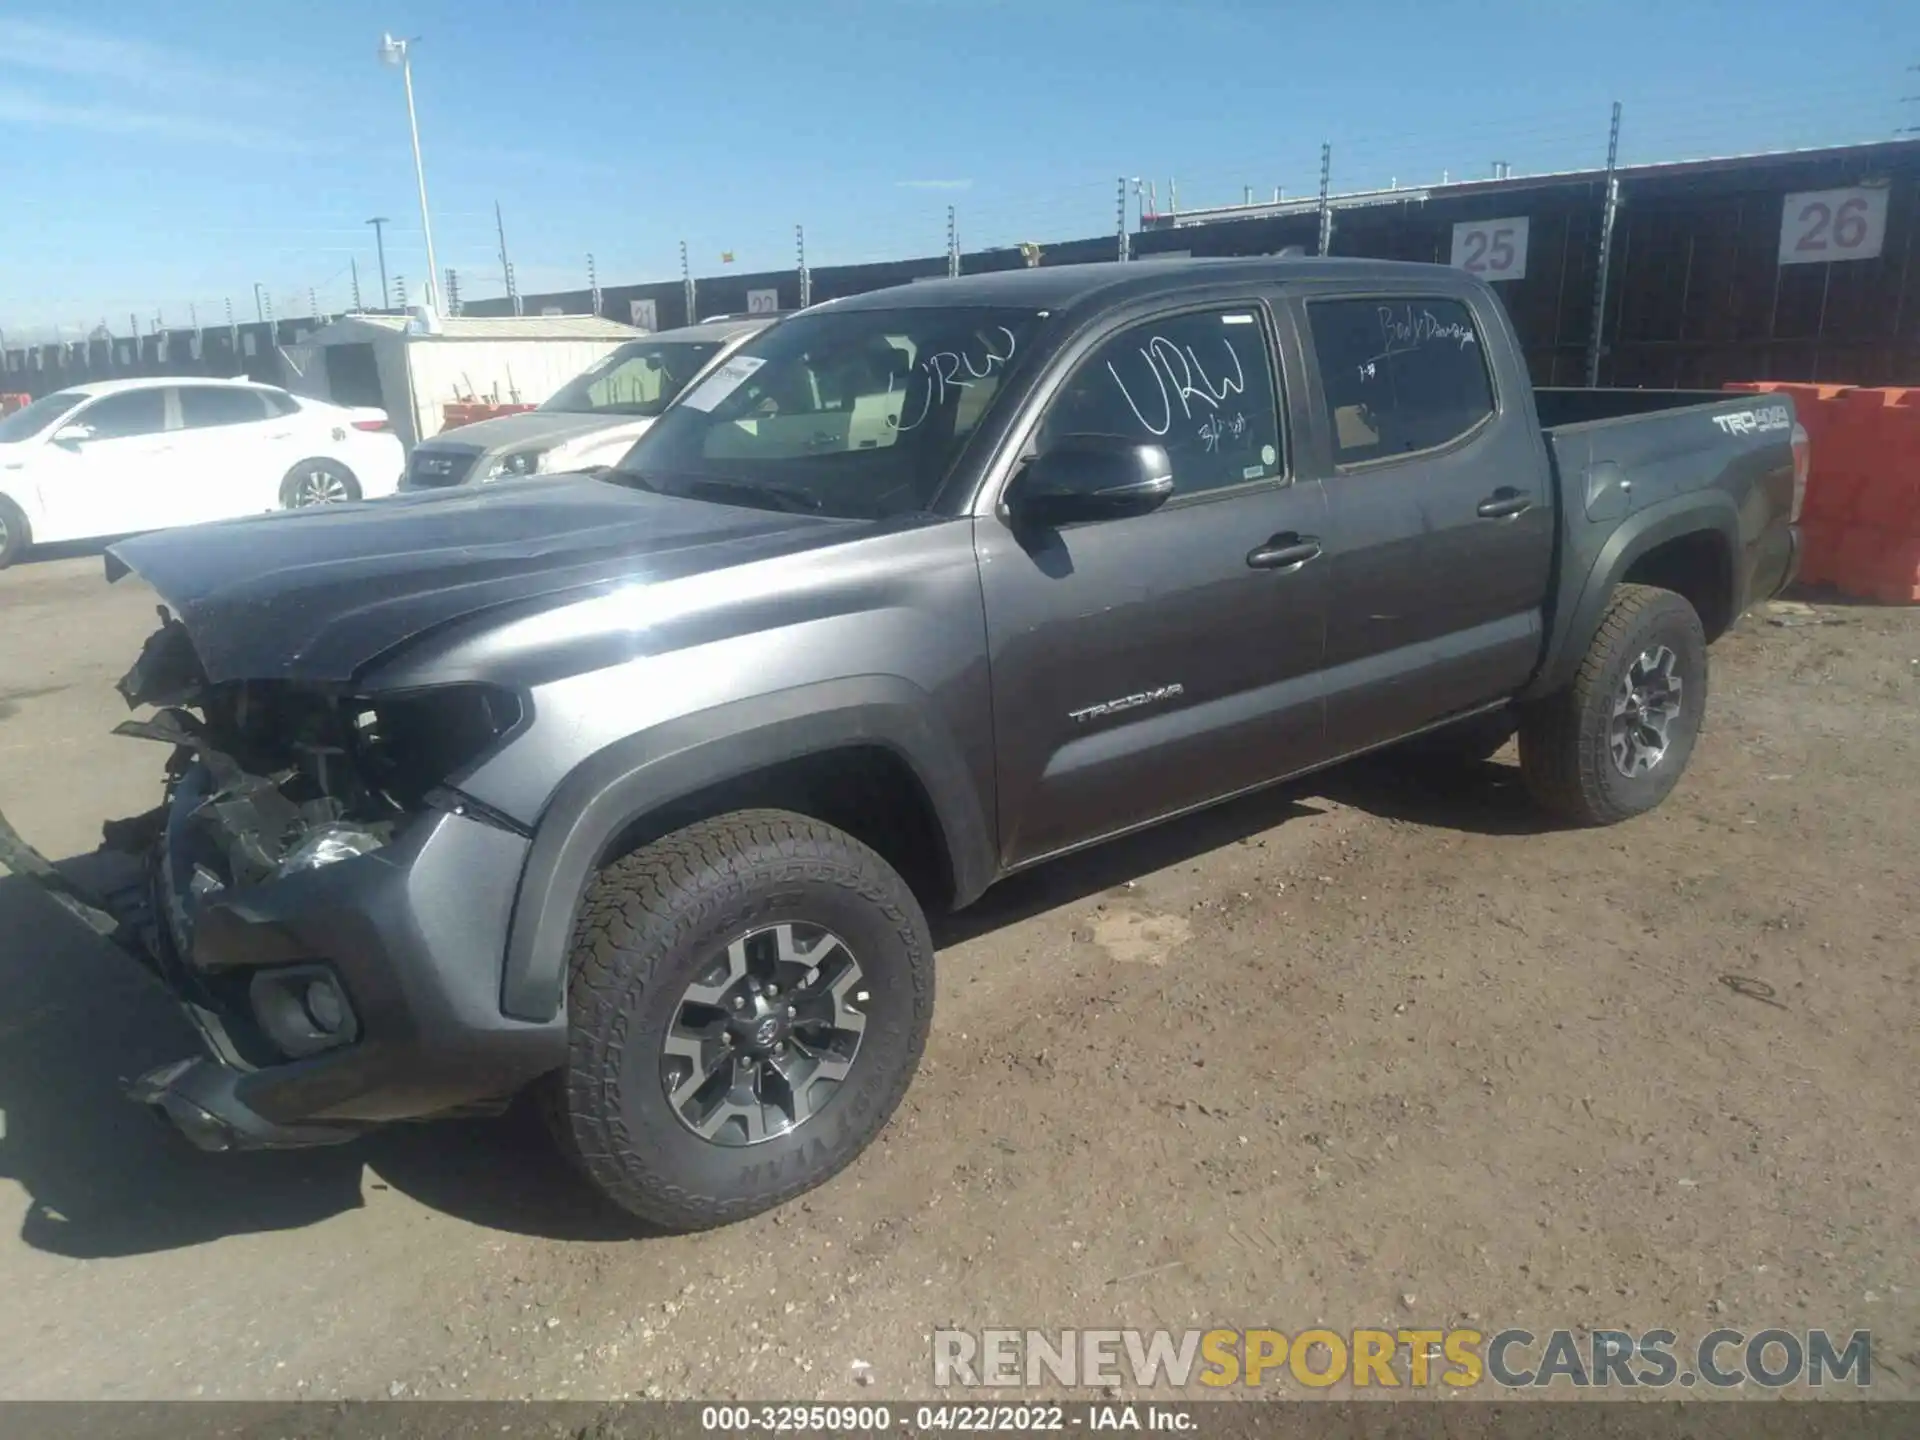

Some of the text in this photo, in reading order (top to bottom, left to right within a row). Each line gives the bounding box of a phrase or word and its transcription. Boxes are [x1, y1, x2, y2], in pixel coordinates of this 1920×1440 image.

[1463, 229, 1515, 273] 25
[1795, 198, 1869, 252] 26
[1107, 336, 1244, 435] URW
